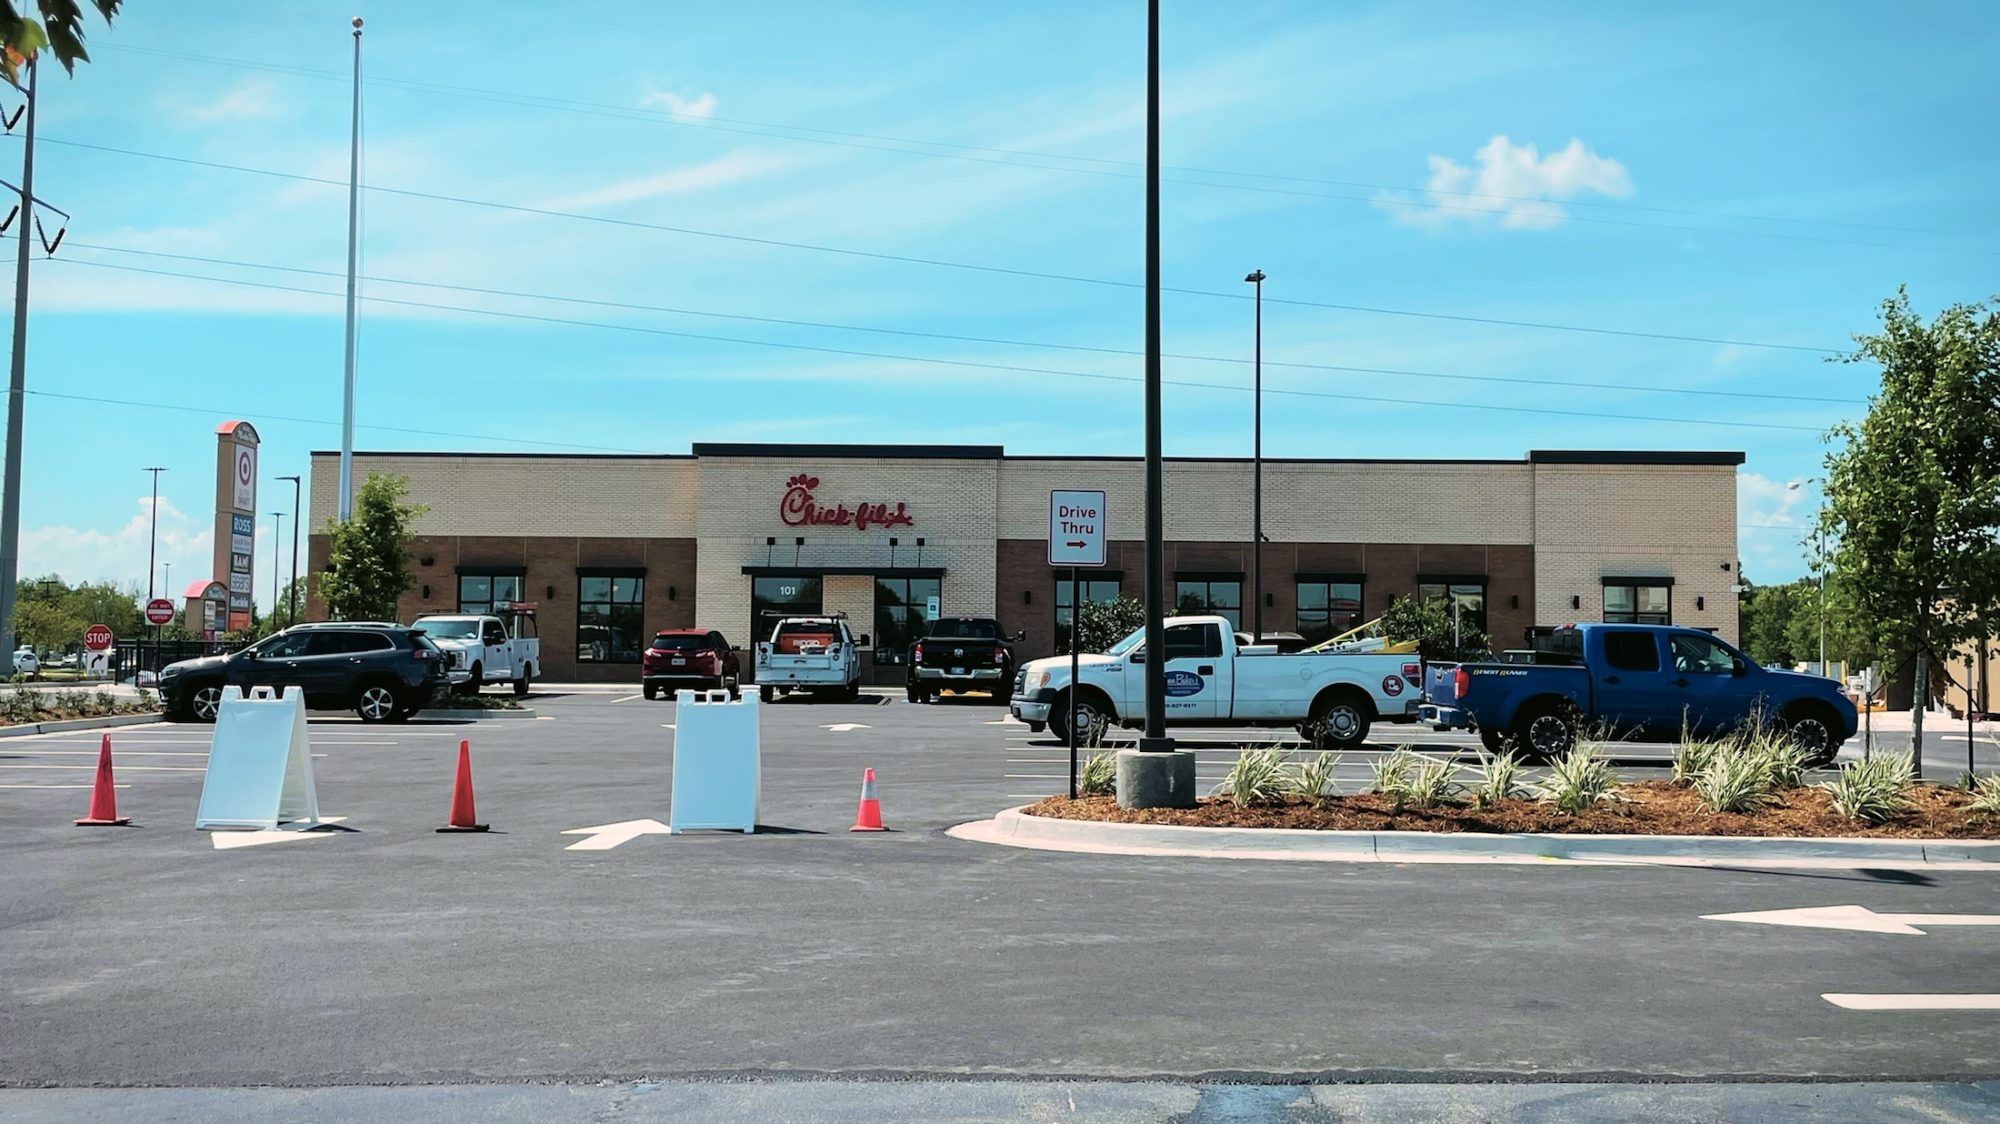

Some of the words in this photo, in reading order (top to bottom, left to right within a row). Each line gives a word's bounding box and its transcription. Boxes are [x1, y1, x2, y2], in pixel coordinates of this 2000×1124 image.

[780, 474, 914, 530] Chick-fil-A
[1060, 505, 1096, 518] Drive
[233, 518, 251, 532] ROSS
[1061, 522, 1093, 534] Thru
[780, 586, 795, 596] 101
[87, 633, 111, 644] STOP
